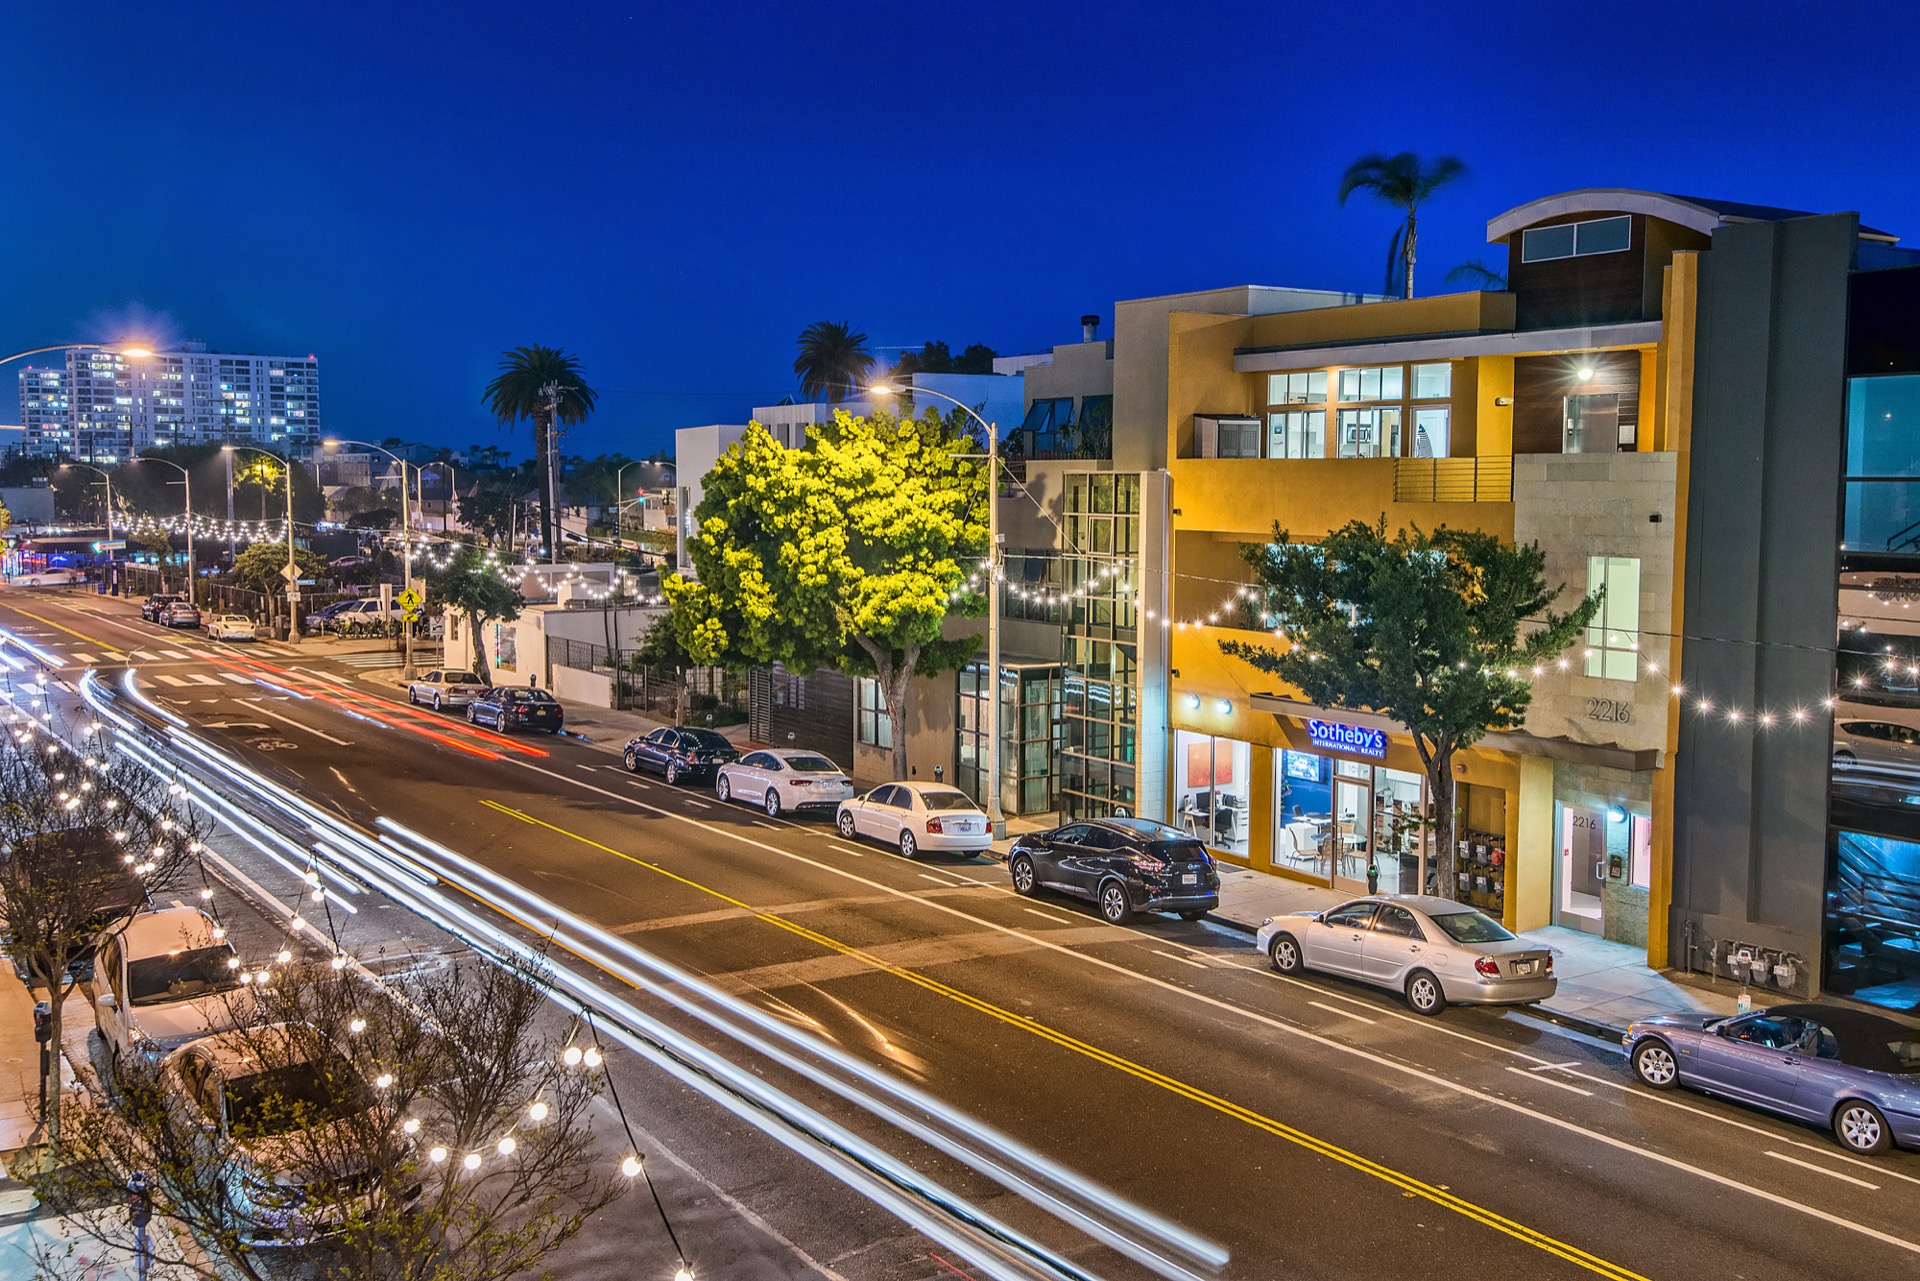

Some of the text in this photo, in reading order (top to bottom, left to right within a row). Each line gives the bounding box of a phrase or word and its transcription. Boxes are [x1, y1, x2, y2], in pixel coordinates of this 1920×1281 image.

[1587, 697, 1630, 724] 2216
[1309, 719, 1383, 748] Sotheby's
[1312, 739, 1383, 757] INTERNATIONAL REALTY
[1572, 815, 1596, 830] 2216
